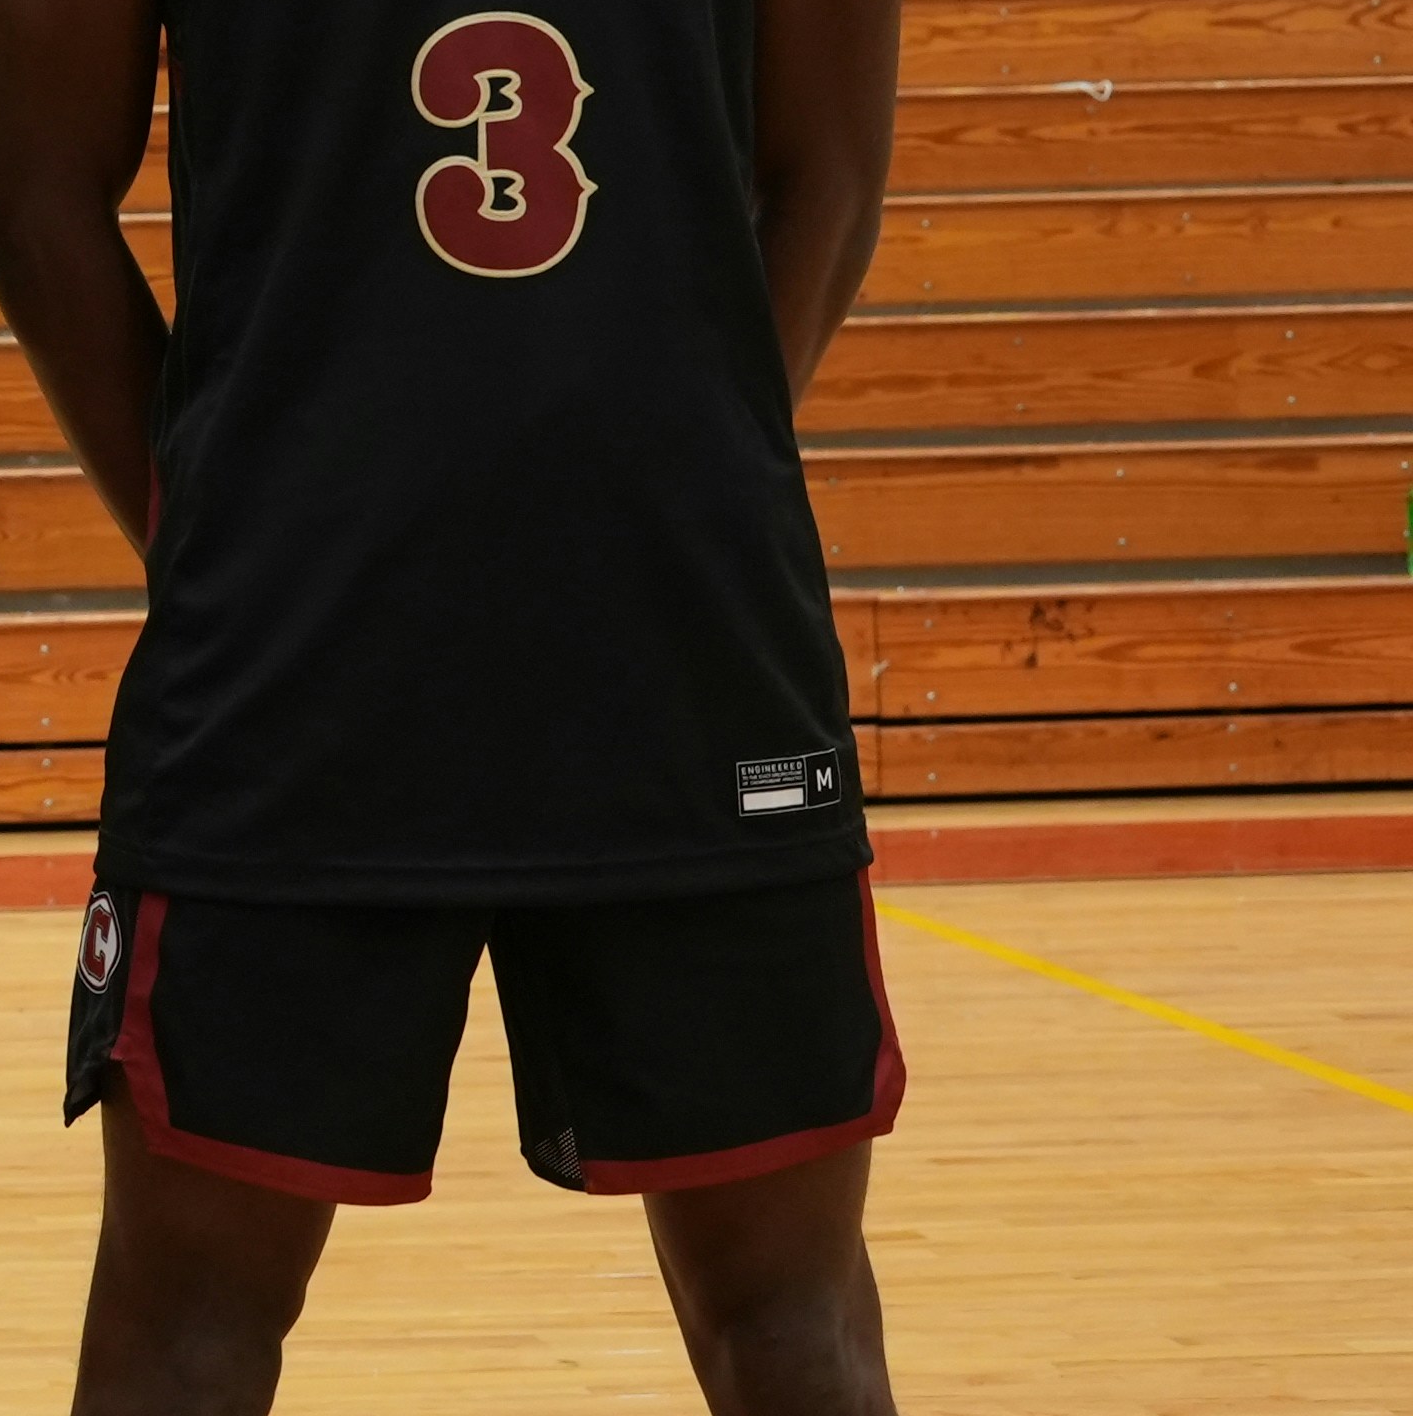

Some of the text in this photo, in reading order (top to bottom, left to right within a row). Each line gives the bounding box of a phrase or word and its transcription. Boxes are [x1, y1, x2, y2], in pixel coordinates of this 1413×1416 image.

[411, 11, 598, 278] 3
[741, 761, 803, 775] ENGINEERED
[816, 766, 833, 792] M
